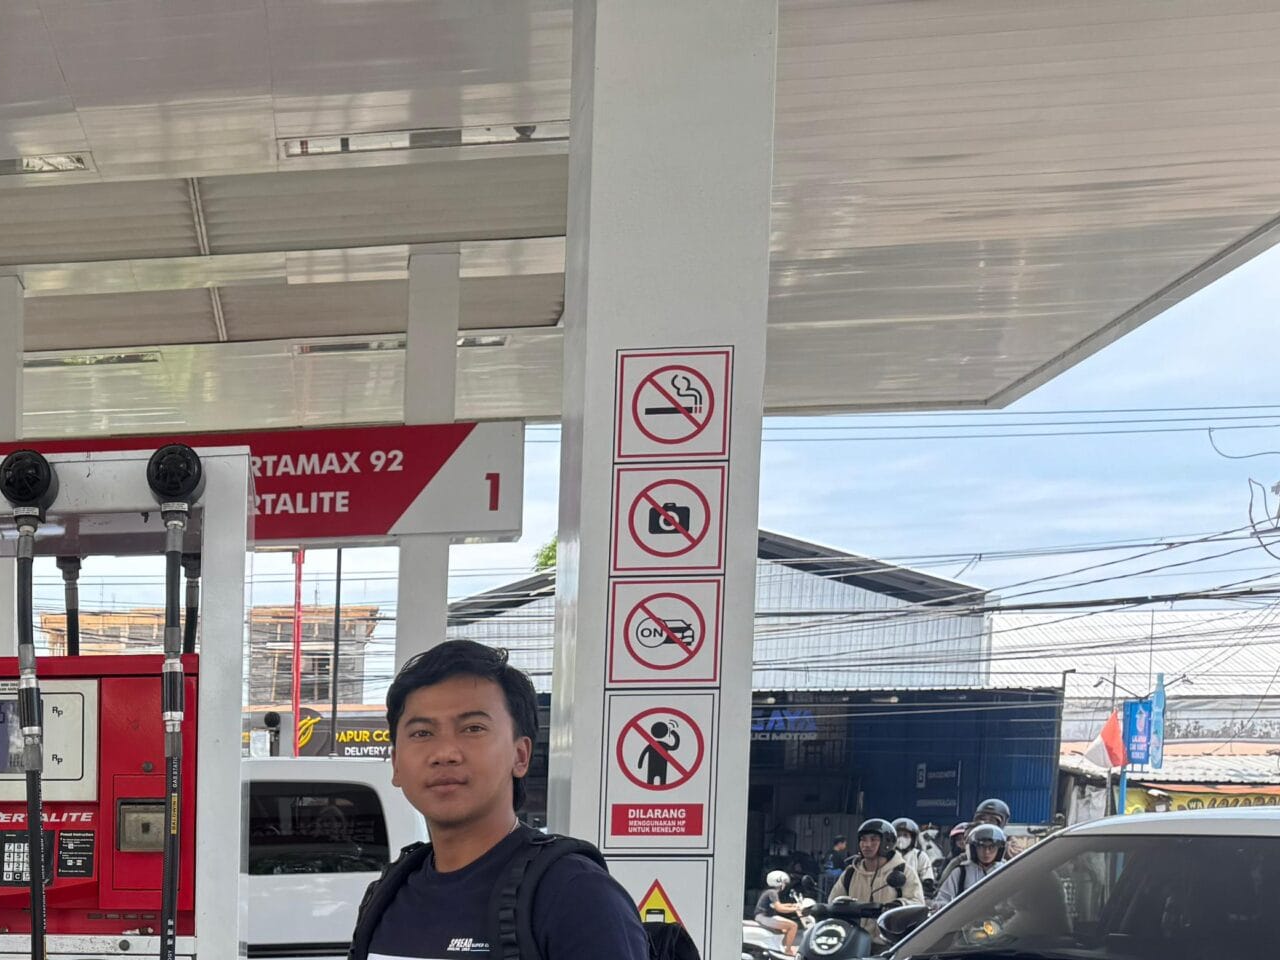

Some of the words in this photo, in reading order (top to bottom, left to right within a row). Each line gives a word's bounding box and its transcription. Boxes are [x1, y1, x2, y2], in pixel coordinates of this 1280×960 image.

[250, 452, 361, 477] RTAMAX
[369, 450, 404, 472] 92
[485, 472, 500, 511] 1
[250, 491, 350, 515] RTALITE
[640, 628, 663, 638] ON
[772, 732, 817, 741] MOTOR
[344, 746, 386, 756] DELIVERY
[628, 808, 686, 819] DILARANG
